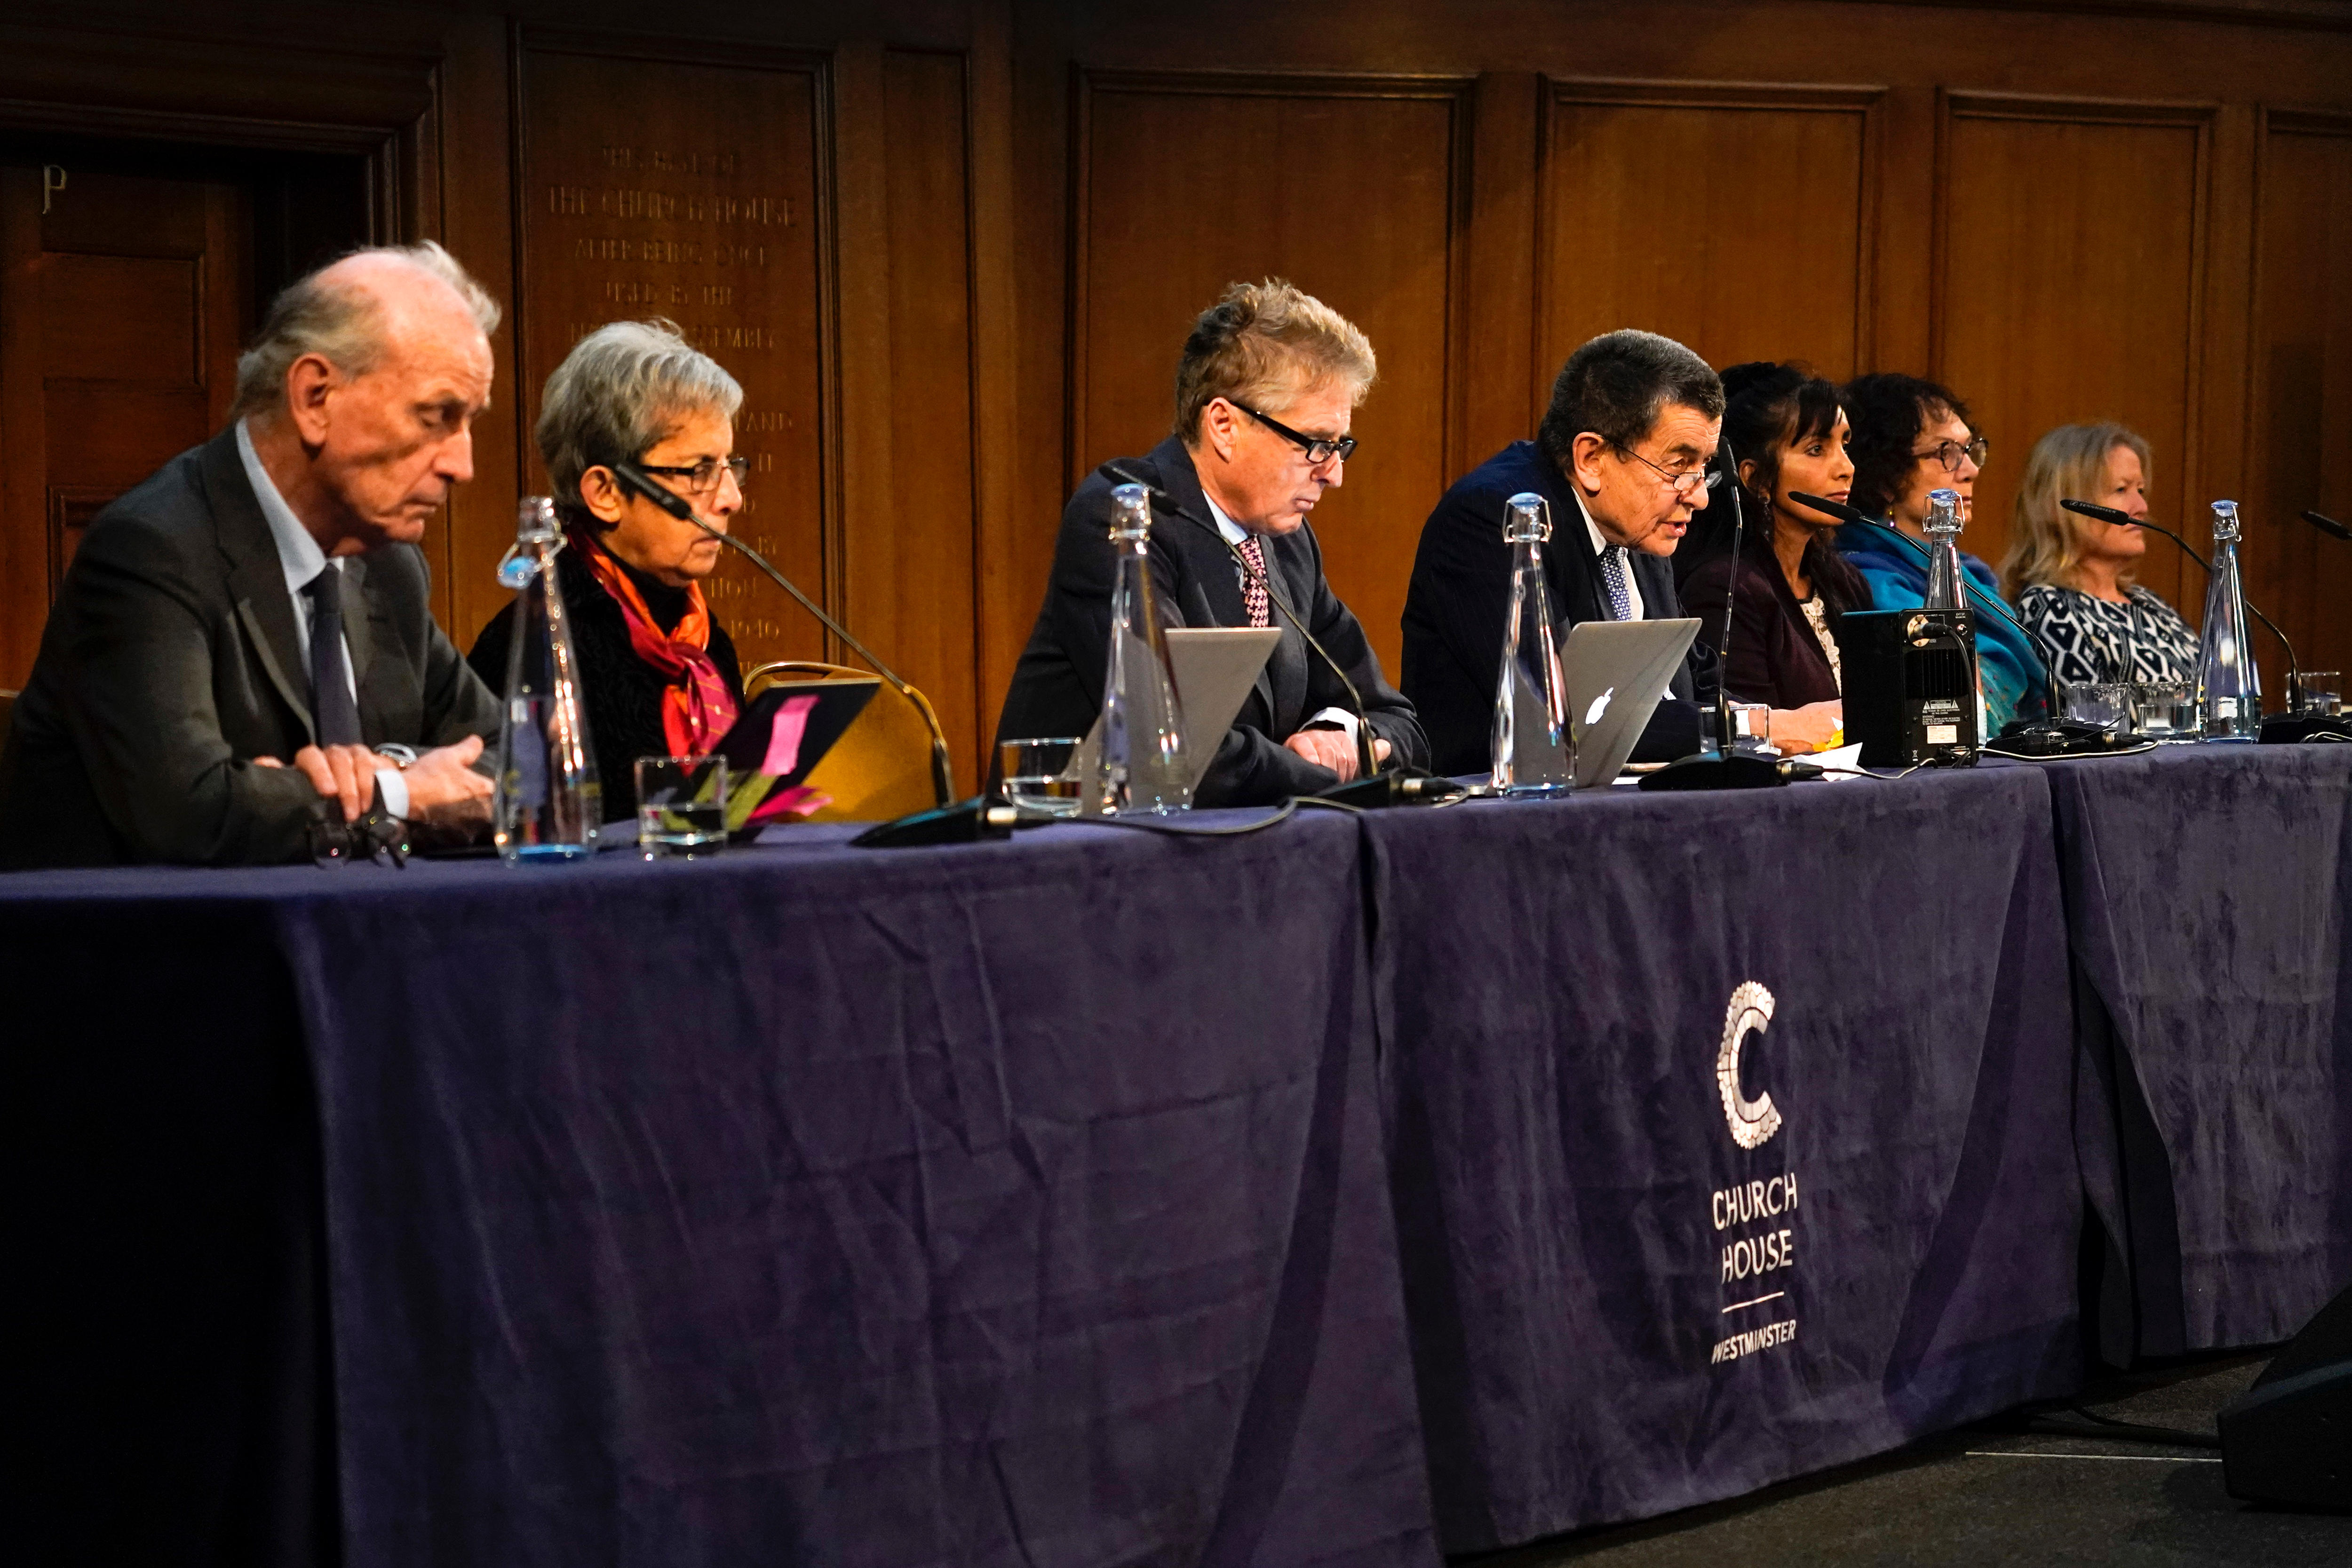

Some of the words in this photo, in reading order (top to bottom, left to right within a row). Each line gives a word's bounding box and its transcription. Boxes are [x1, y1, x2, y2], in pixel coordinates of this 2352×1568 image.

[42, 164, 67, 215] P
[547, 184, 592, 216] THE
[602, 189, 704, 221] CHURCH
[715, 193, 796, 227] HOUSE
[575, 238, 637, 260] AFTER
[644, 240, 703, 265] BEING
[713, 245, 770, 267] ONCE
[700, 285, 735, 306] THE
[684, 326, 778, 349] SSEMBLY
[730, 619, 781, 640] 1940
[1712, 1172, 1798, 1231] CHURCH
[1721, 1229, 1793, 1285] HOUSE
[1711, 1319, 1796, 1365] WESTMINSTER
